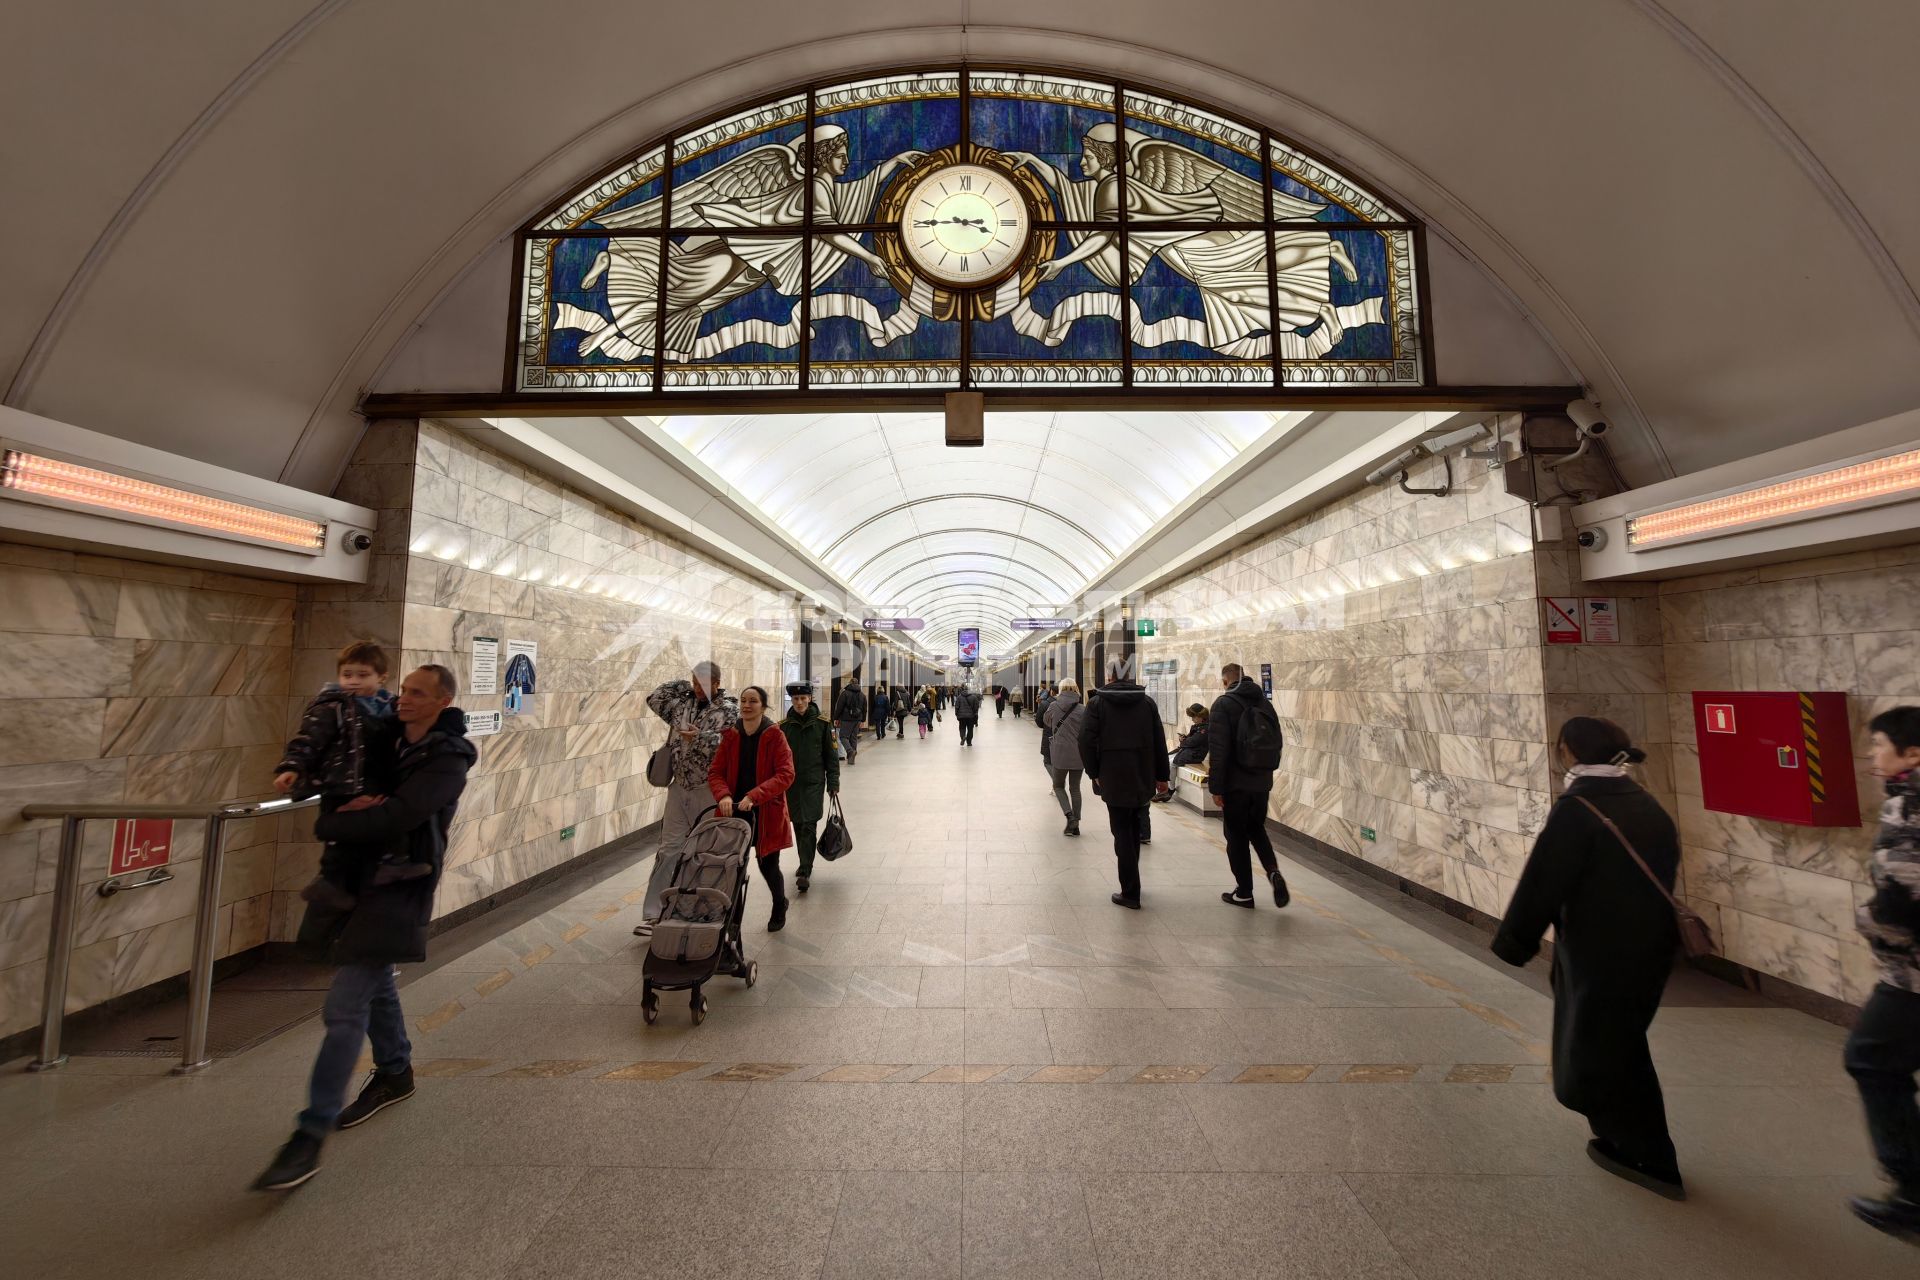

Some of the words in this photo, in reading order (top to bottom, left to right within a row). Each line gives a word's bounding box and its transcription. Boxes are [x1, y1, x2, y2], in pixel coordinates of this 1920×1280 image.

[959, 175, 972, 191] XII
[1000, 219, 1017, 227] III
[960, 255, 969, 272] VI
